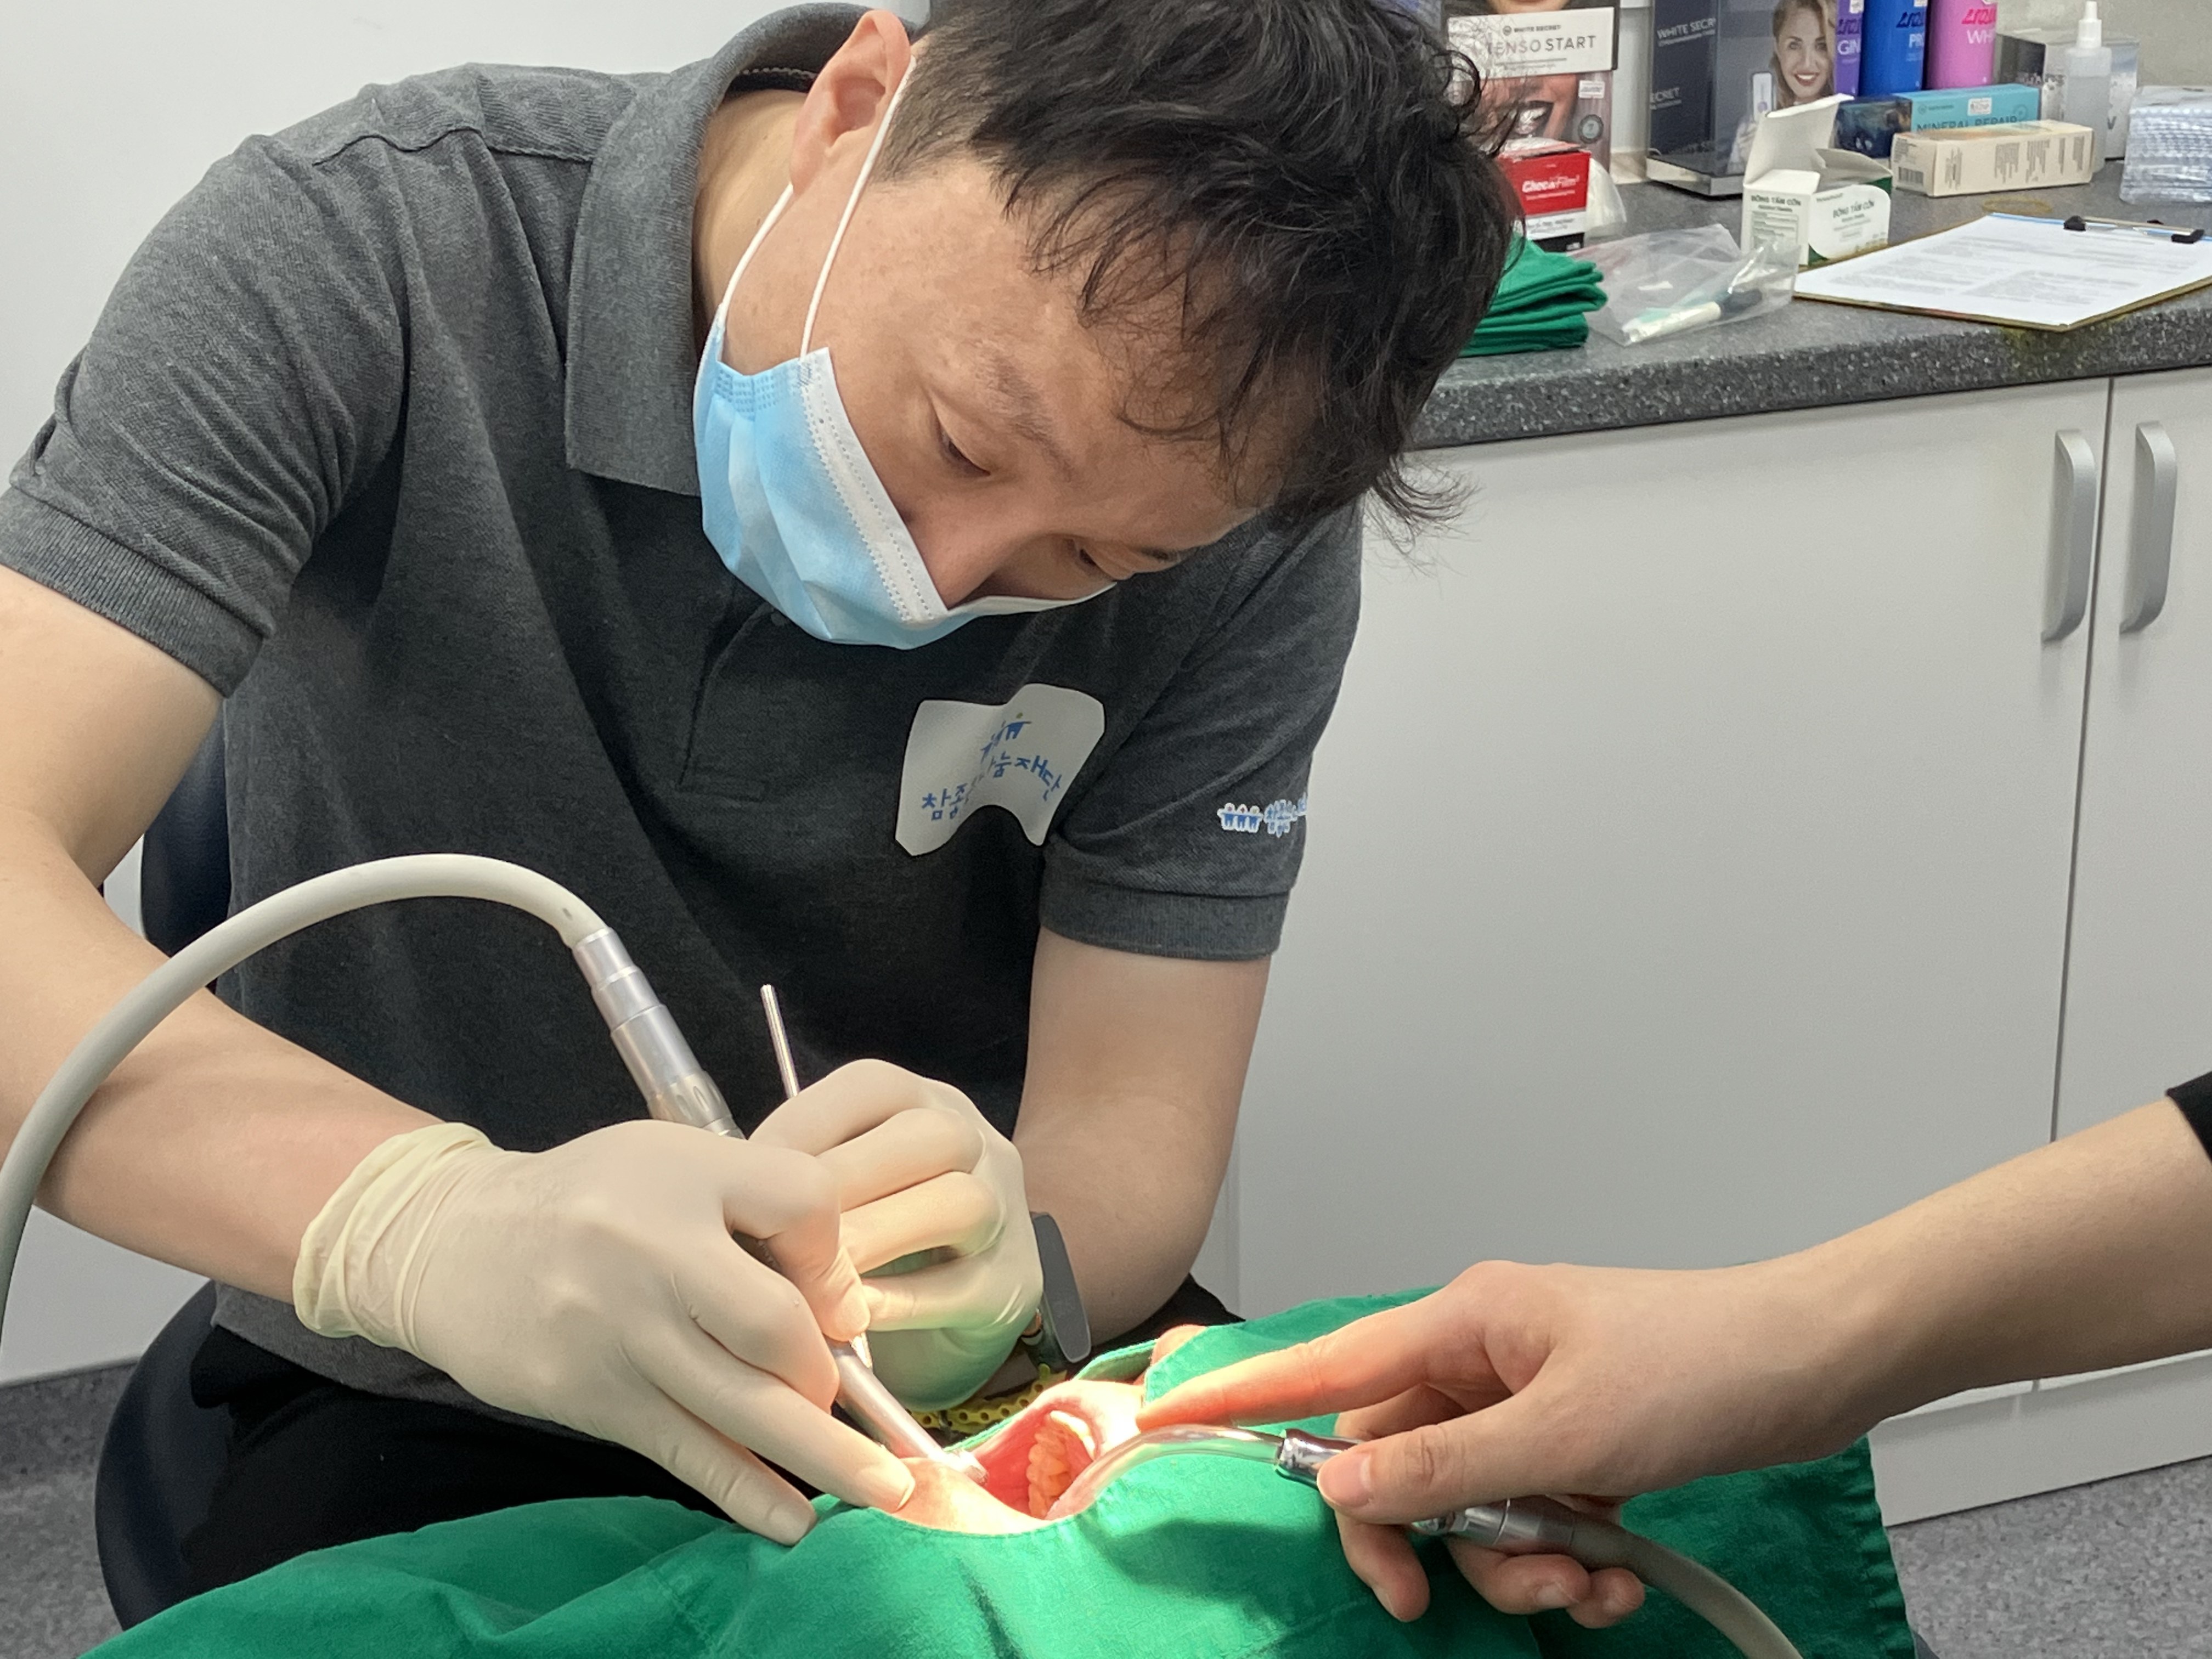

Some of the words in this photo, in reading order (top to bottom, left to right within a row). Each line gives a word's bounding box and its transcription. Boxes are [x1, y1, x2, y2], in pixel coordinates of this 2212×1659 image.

[1657, 24, 1688, 39] WHITE
[1486, 40, 1541, 55] ENSO
[1545, 36, 1596, 52] START
